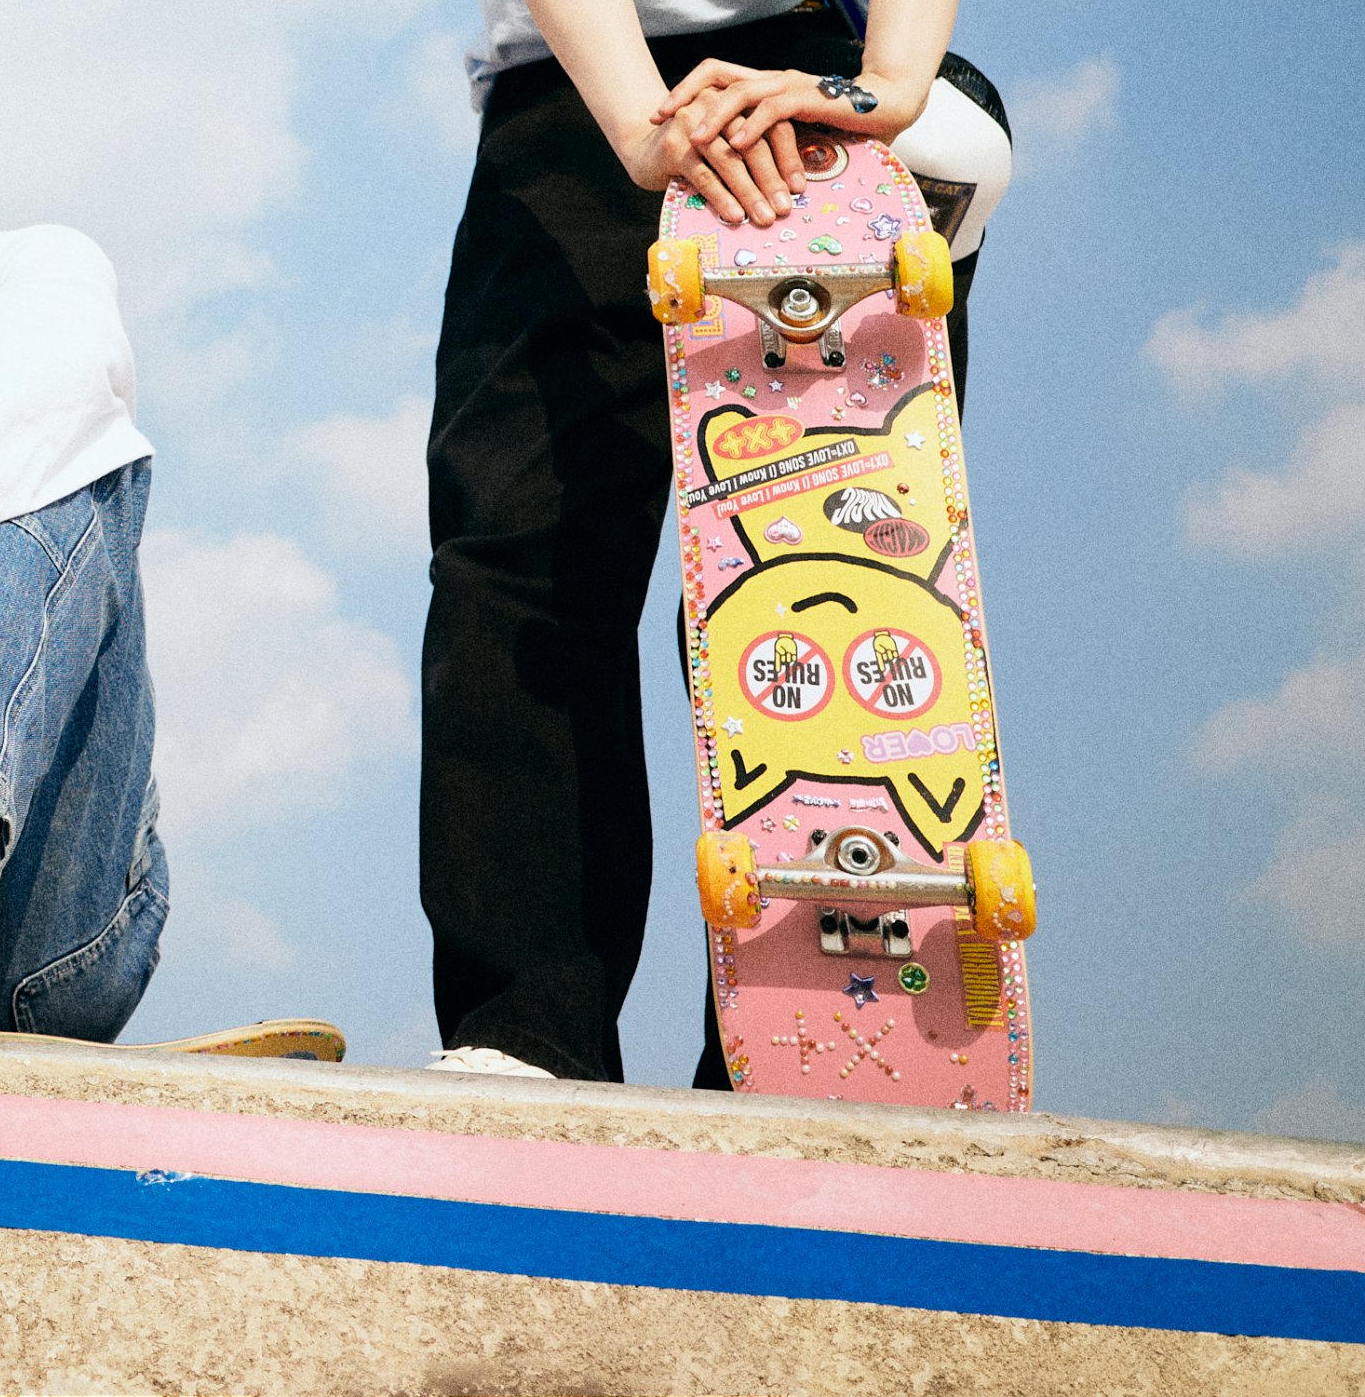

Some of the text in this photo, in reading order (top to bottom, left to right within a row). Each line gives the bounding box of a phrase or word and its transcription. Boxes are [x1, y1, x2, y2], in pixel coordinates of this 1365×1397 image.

[739, 467, 768, 485] Know
[780, 459, 806, 475] SONG
[812, 469, 840, 487] SONG
[707, 482, 731, 499] Love
[772, 479, 801, 496] Know
[740, 492, 764, 508] Love
[753, 659, 820, 686] RULES
[857, 655, 927, 685] RULES
[772, 684, 801, 709] NO
[882, 682, 915, 708] NO
[959, 942, 1005, 1027] TOMORROW
